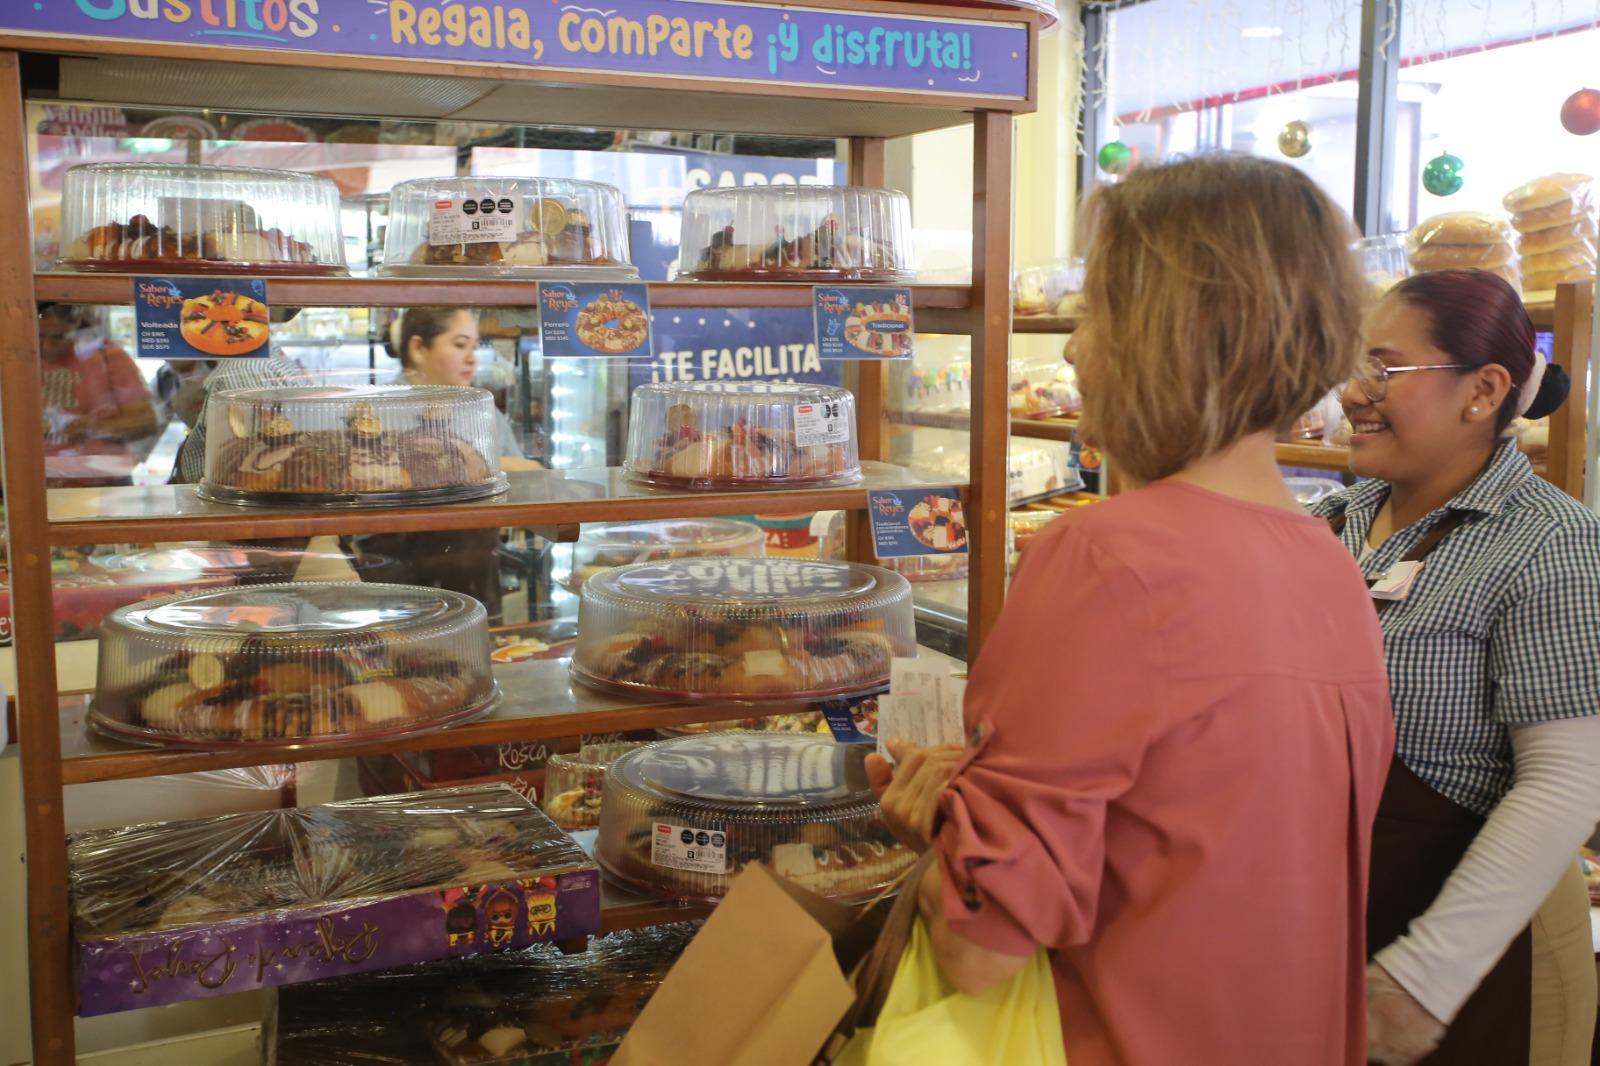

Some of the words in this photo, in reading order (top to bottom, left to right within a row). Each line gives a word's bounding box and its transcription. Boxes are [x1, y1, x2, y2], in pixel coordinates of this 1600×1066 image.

[390, 0, 544, 60] Regala,
[812, 24, 972, 70] disfruta!
[139, 283, 168, 293] Sabor
[542, 289, 565, 299] Sabor
[147, 293, 185, 309] Reyes
[548, 299, 578, 312] Reyes
[701, 344, 822, 380] FACILITA
[497, 741, 549, 770] Rosca
